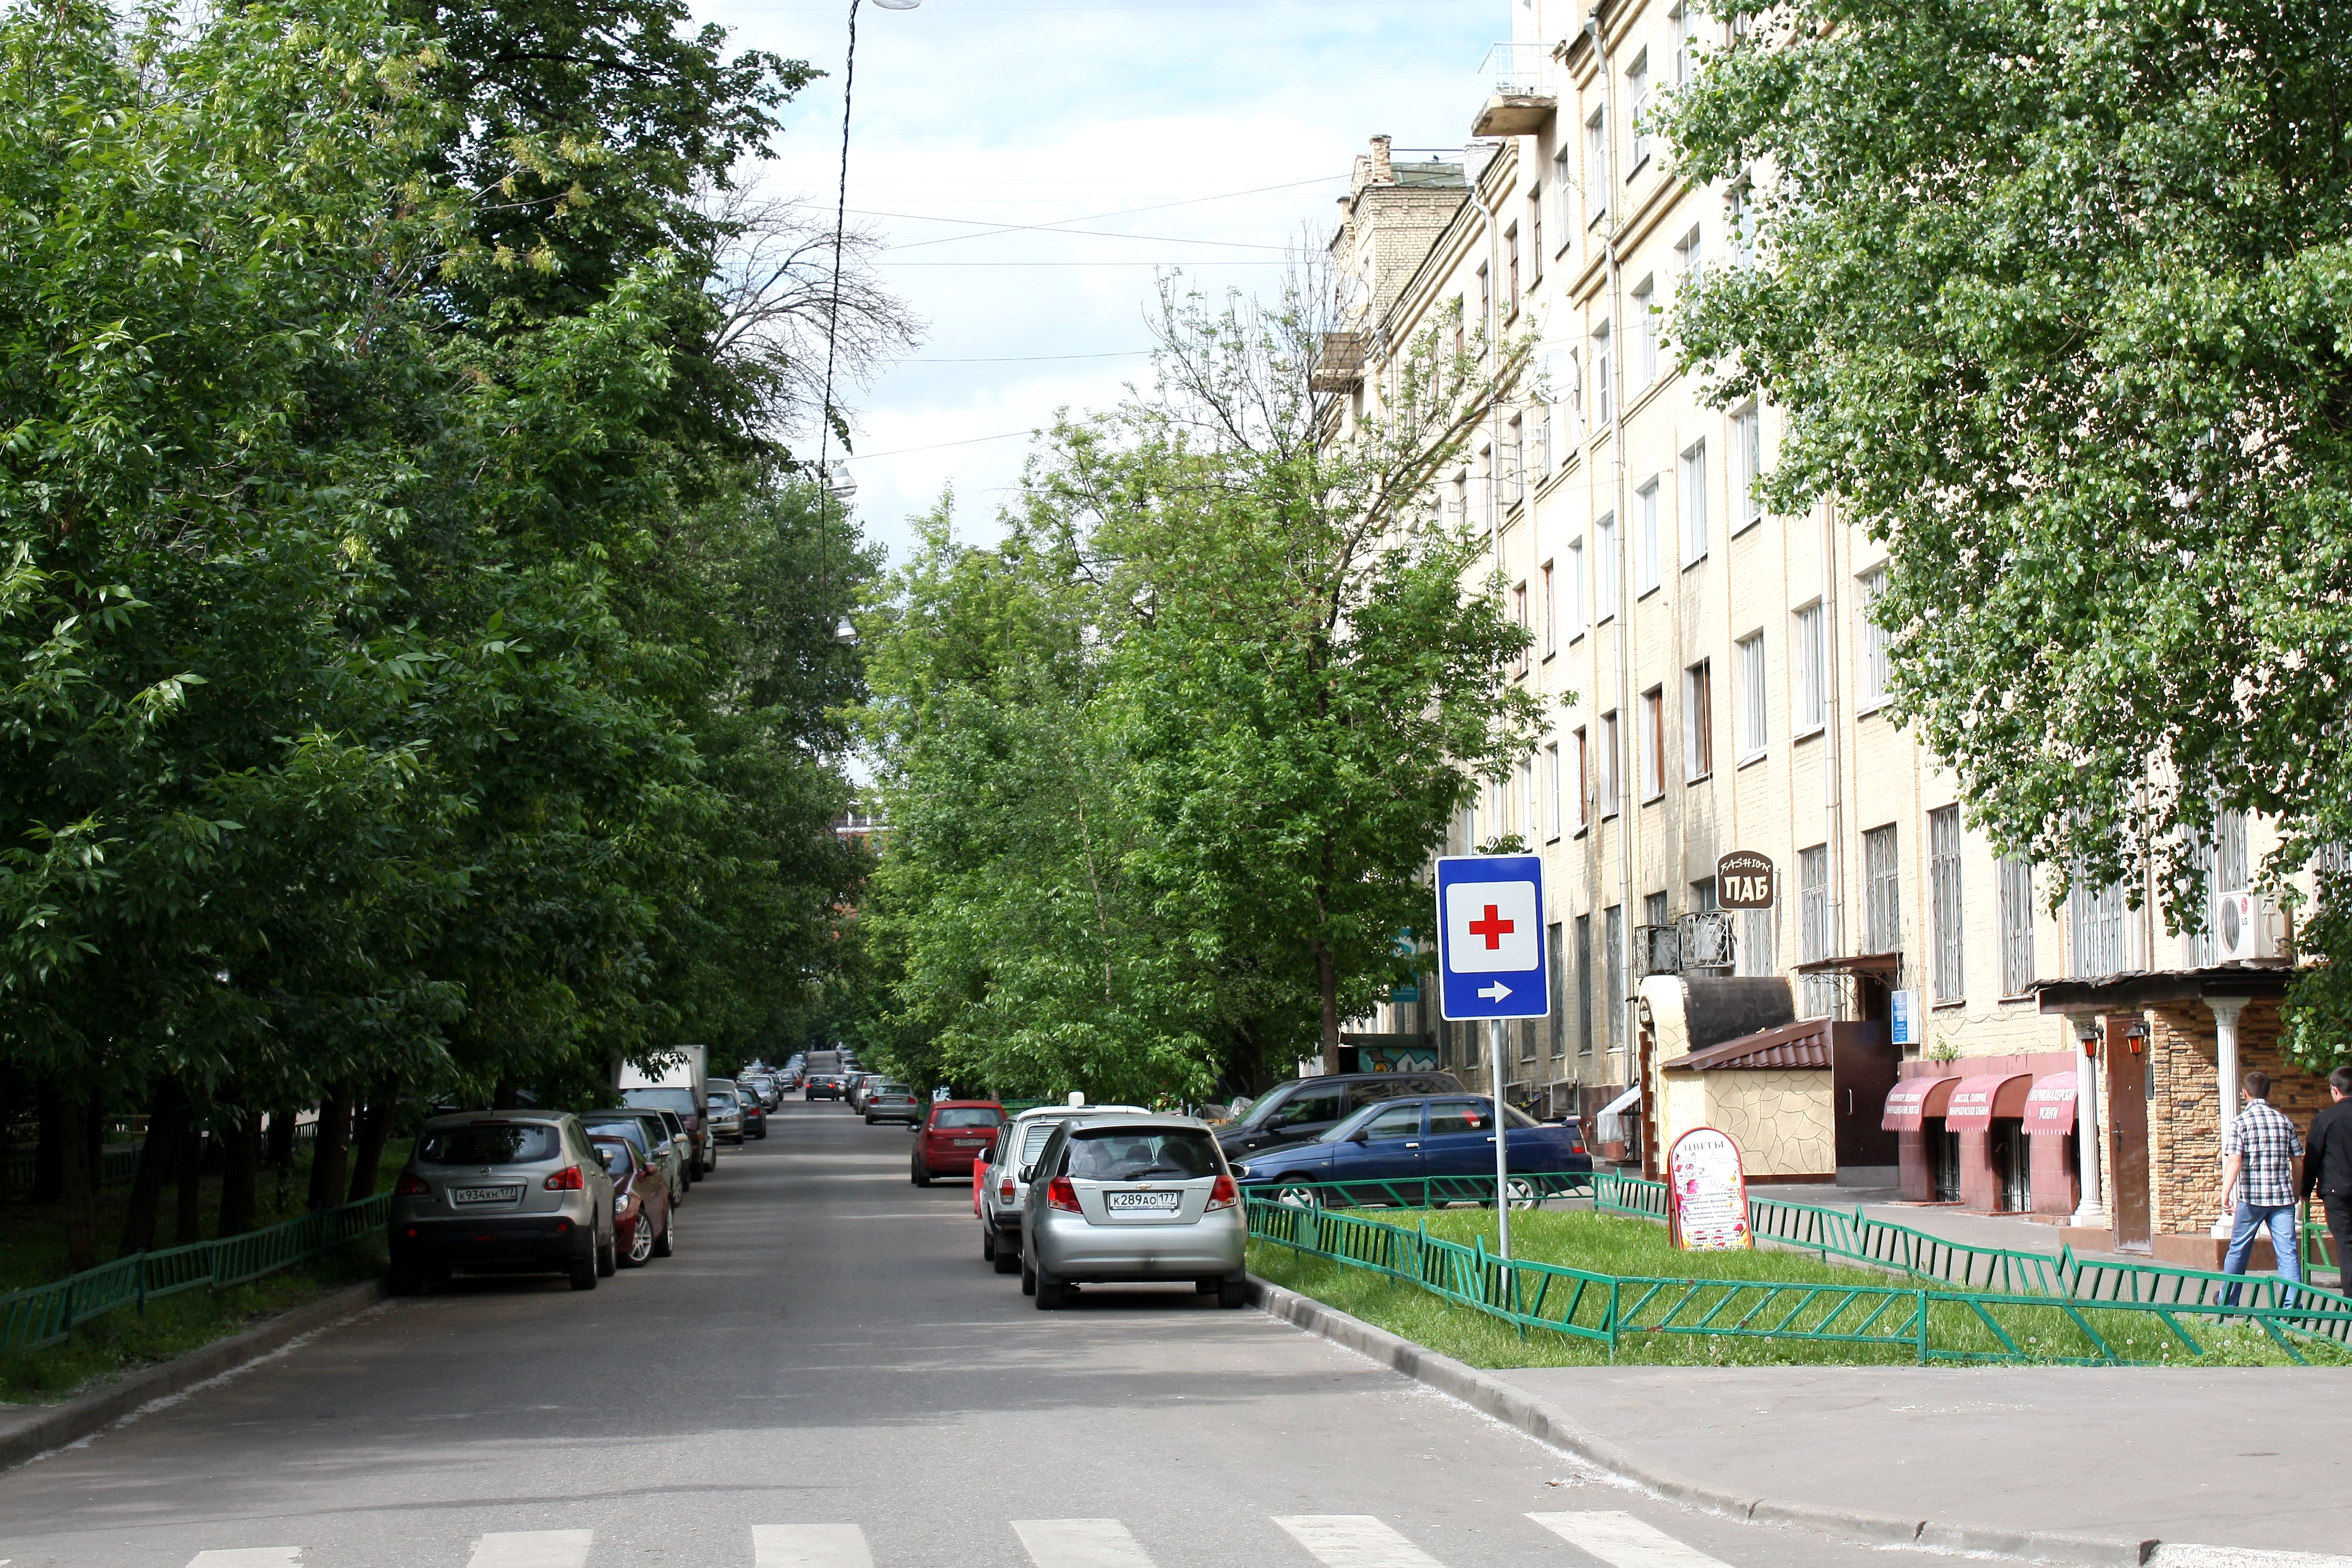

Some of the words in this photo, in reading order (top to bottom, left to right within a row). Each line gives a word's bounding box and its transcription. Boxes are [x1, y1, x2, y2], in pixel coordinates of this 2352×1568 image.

[1721, 858, 1771, 875] FASHION
[1724, 875, 1768, 902] ПАБ
[2029, 1088, 2077, 1102] ПАРИКМАХЕРСКИЕ
[2038, 1107, 2059, 1120] УСЛУГИ
[1684, 1141, 1724, 1152] ЦВЕТЫ
[460, 1190, 497, 1200] К934ХН
[1114, 1194, 1156, 1205] К289АО
[1159, 1193, 1174, 1201] 177
